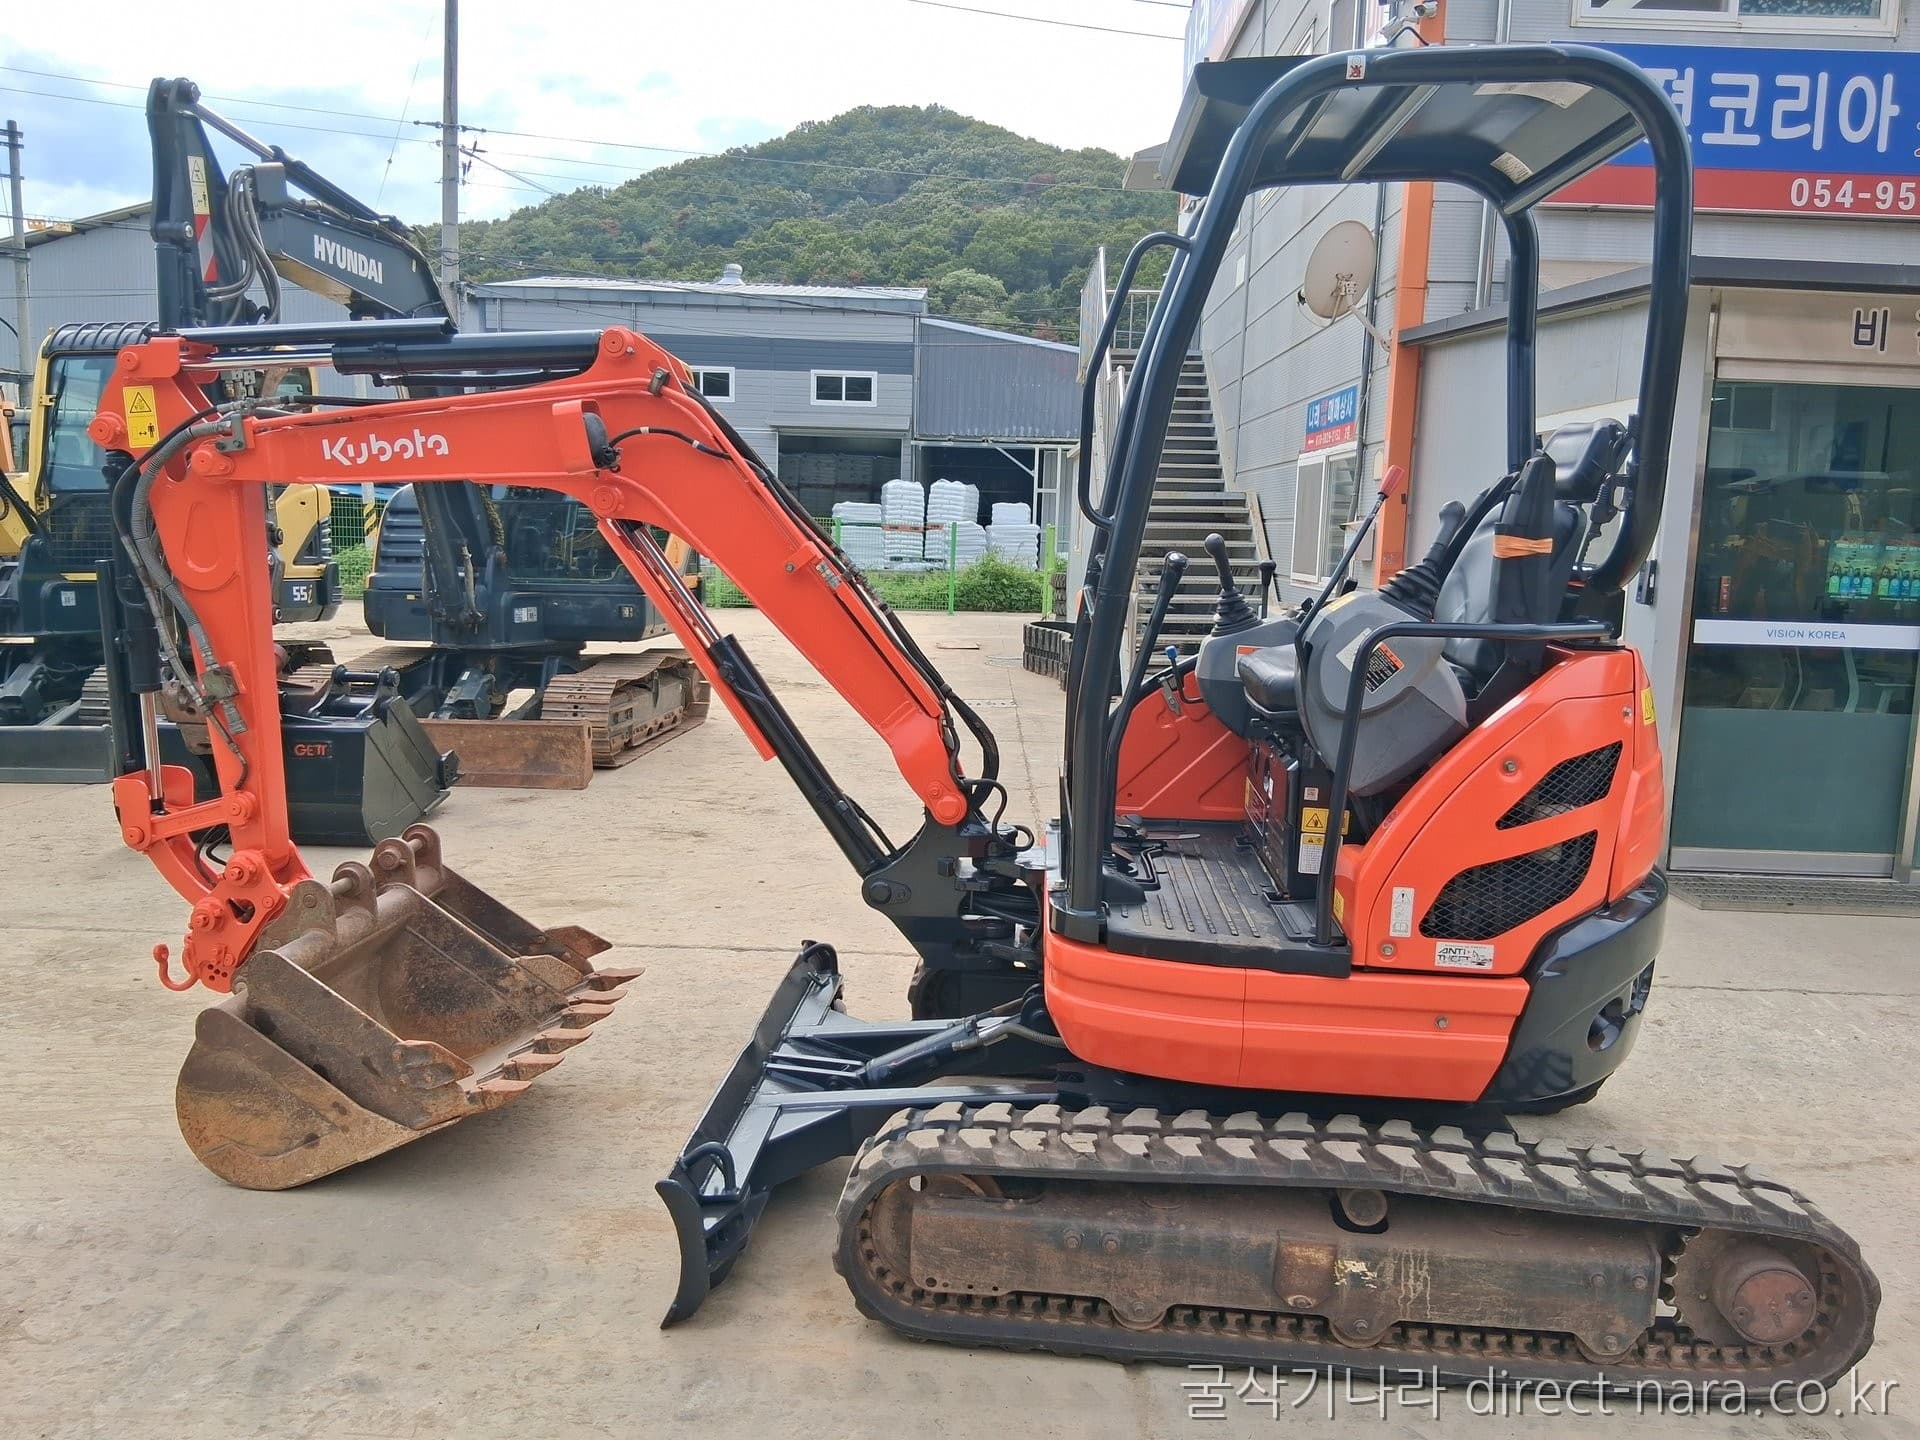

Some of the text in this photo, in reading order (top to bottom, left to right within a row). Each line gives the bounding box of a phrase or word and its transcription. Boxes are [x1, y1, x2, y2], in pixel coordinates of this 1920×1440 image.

[1790, 178, 1917, 211] 054-95
[313, 234, 383, 284] HYUNDAI
[321, 428, 449, 465] Kubota
[1766, 629, 1846, 640] VISION KOREA
